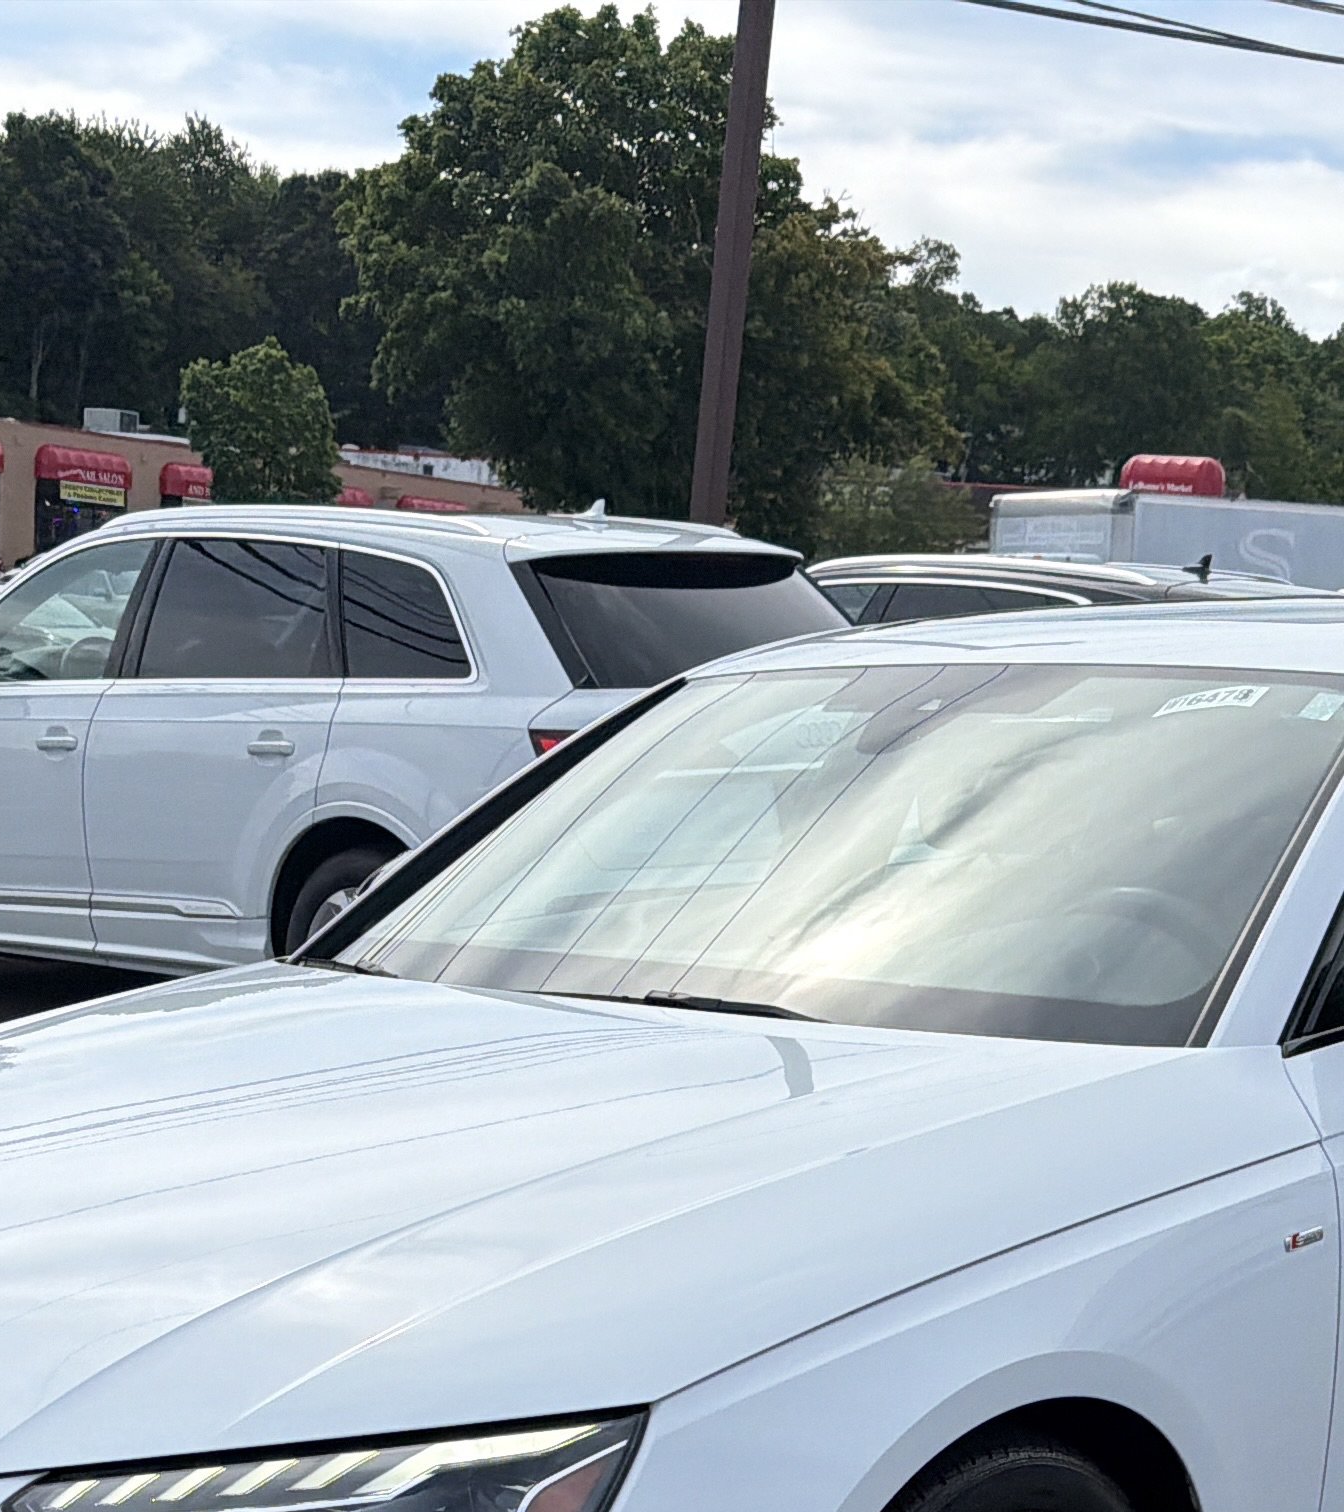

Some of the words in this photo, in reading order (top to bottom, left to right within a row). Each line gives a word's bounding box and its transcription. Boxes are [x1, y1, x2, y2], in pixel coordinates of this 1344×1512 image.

[79, 469, 97, 482] NAIL
[98, 472, 125, 485] SALON
[1166, 482, 1193, 493] Market
